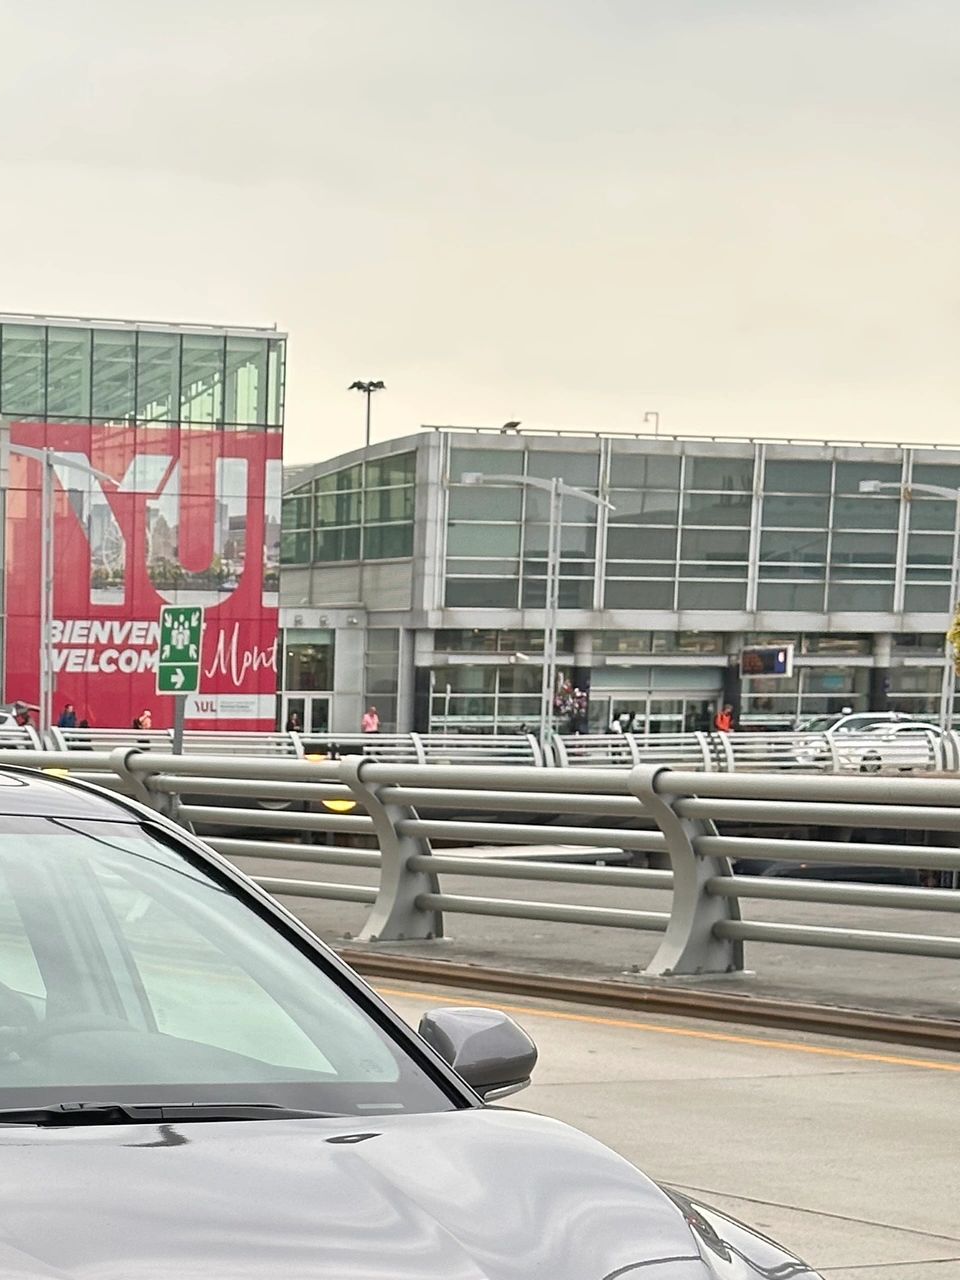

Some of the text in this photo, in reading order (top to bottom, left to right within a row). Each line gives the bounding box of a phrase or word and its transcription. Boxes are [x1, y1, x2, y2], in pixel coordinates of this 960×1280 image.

[48, 619, 206, 645] BIENVEN
[40, 648, 160, 674] WELCOM
[193, 700, 217, 713] YUL
